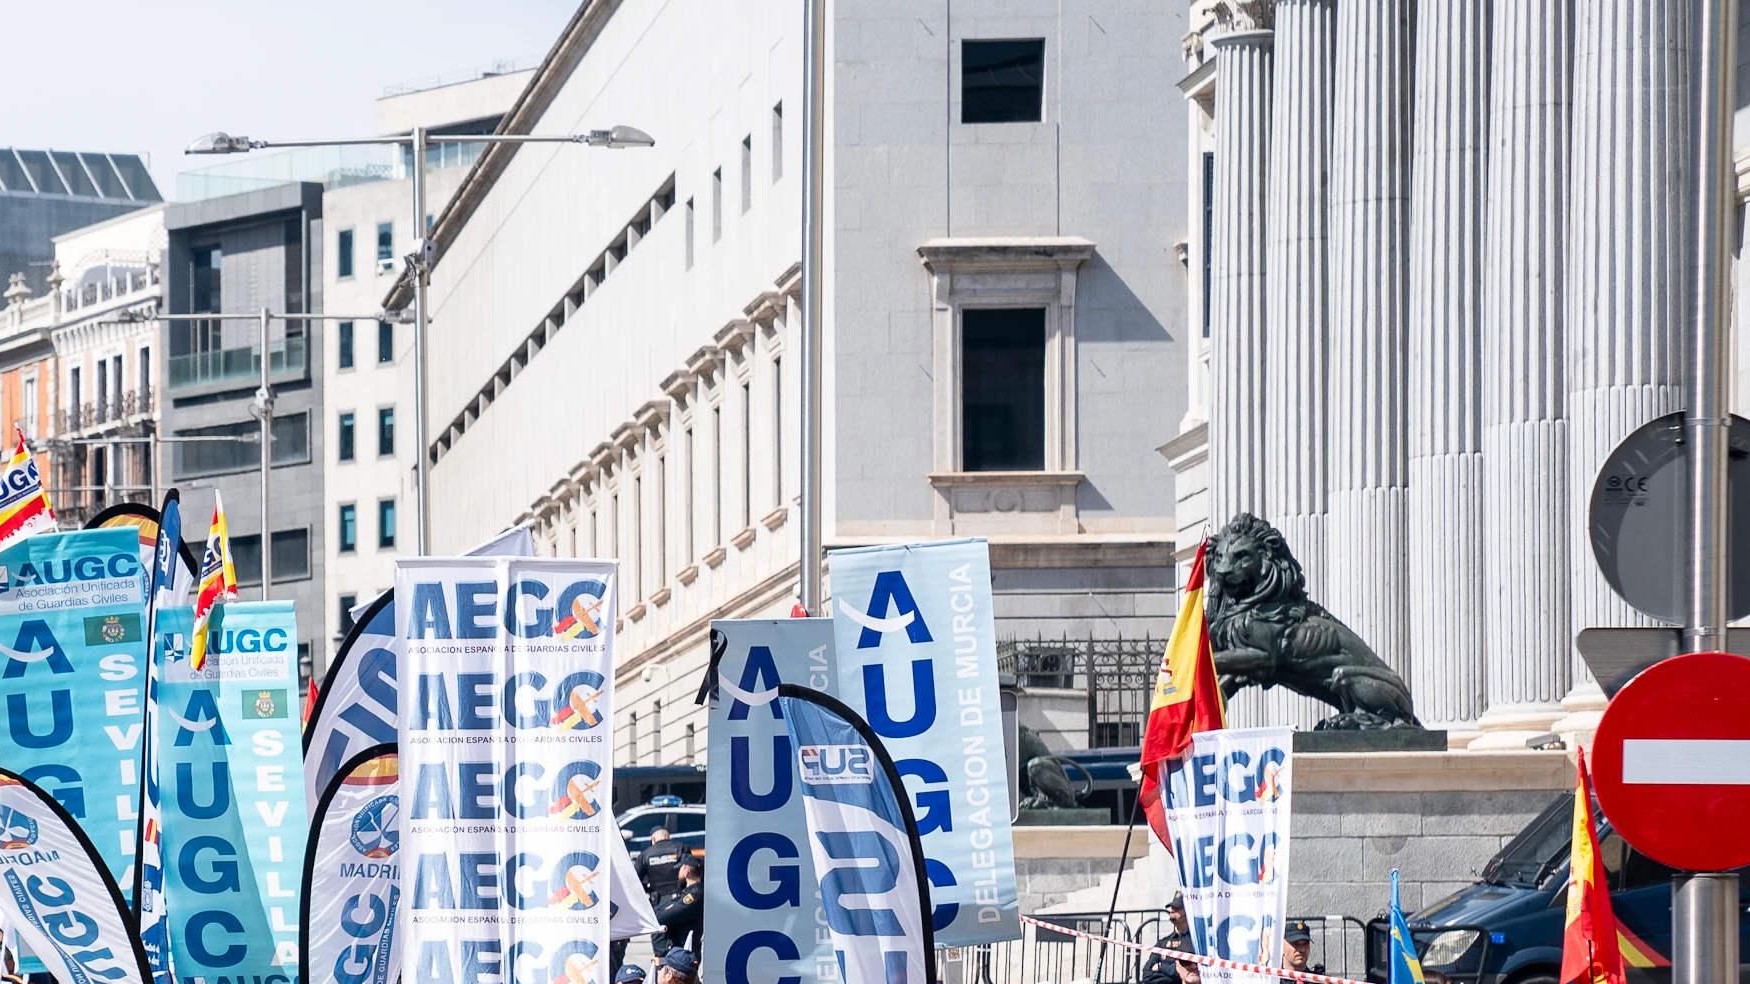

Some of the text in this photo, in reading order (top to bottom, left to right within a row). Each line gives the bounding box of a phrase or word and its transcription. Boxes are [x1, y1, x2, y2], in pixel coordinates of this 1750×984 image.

[12, 552, 138, 587] AUGC
[15, 578, 135, 600] Asociación Unificada
[18, 592, 129, 612] de Guardias Civiles
[407, 578, 607, 642] AEGC
[205, 667, 278, 680] Guardias Civiles
[240, 654, 284, 666] Unificada
[409, 670, 605, 732] AEGC
[948, 562, 1002, 924] DELEGACION DE MURCIA
[410, 760, 602, 820] AEGC
[170, 690, 249, 968] AUGC
[340, 862, 400, 879] MADRI
[411, 850, 601, 912] AEGC
